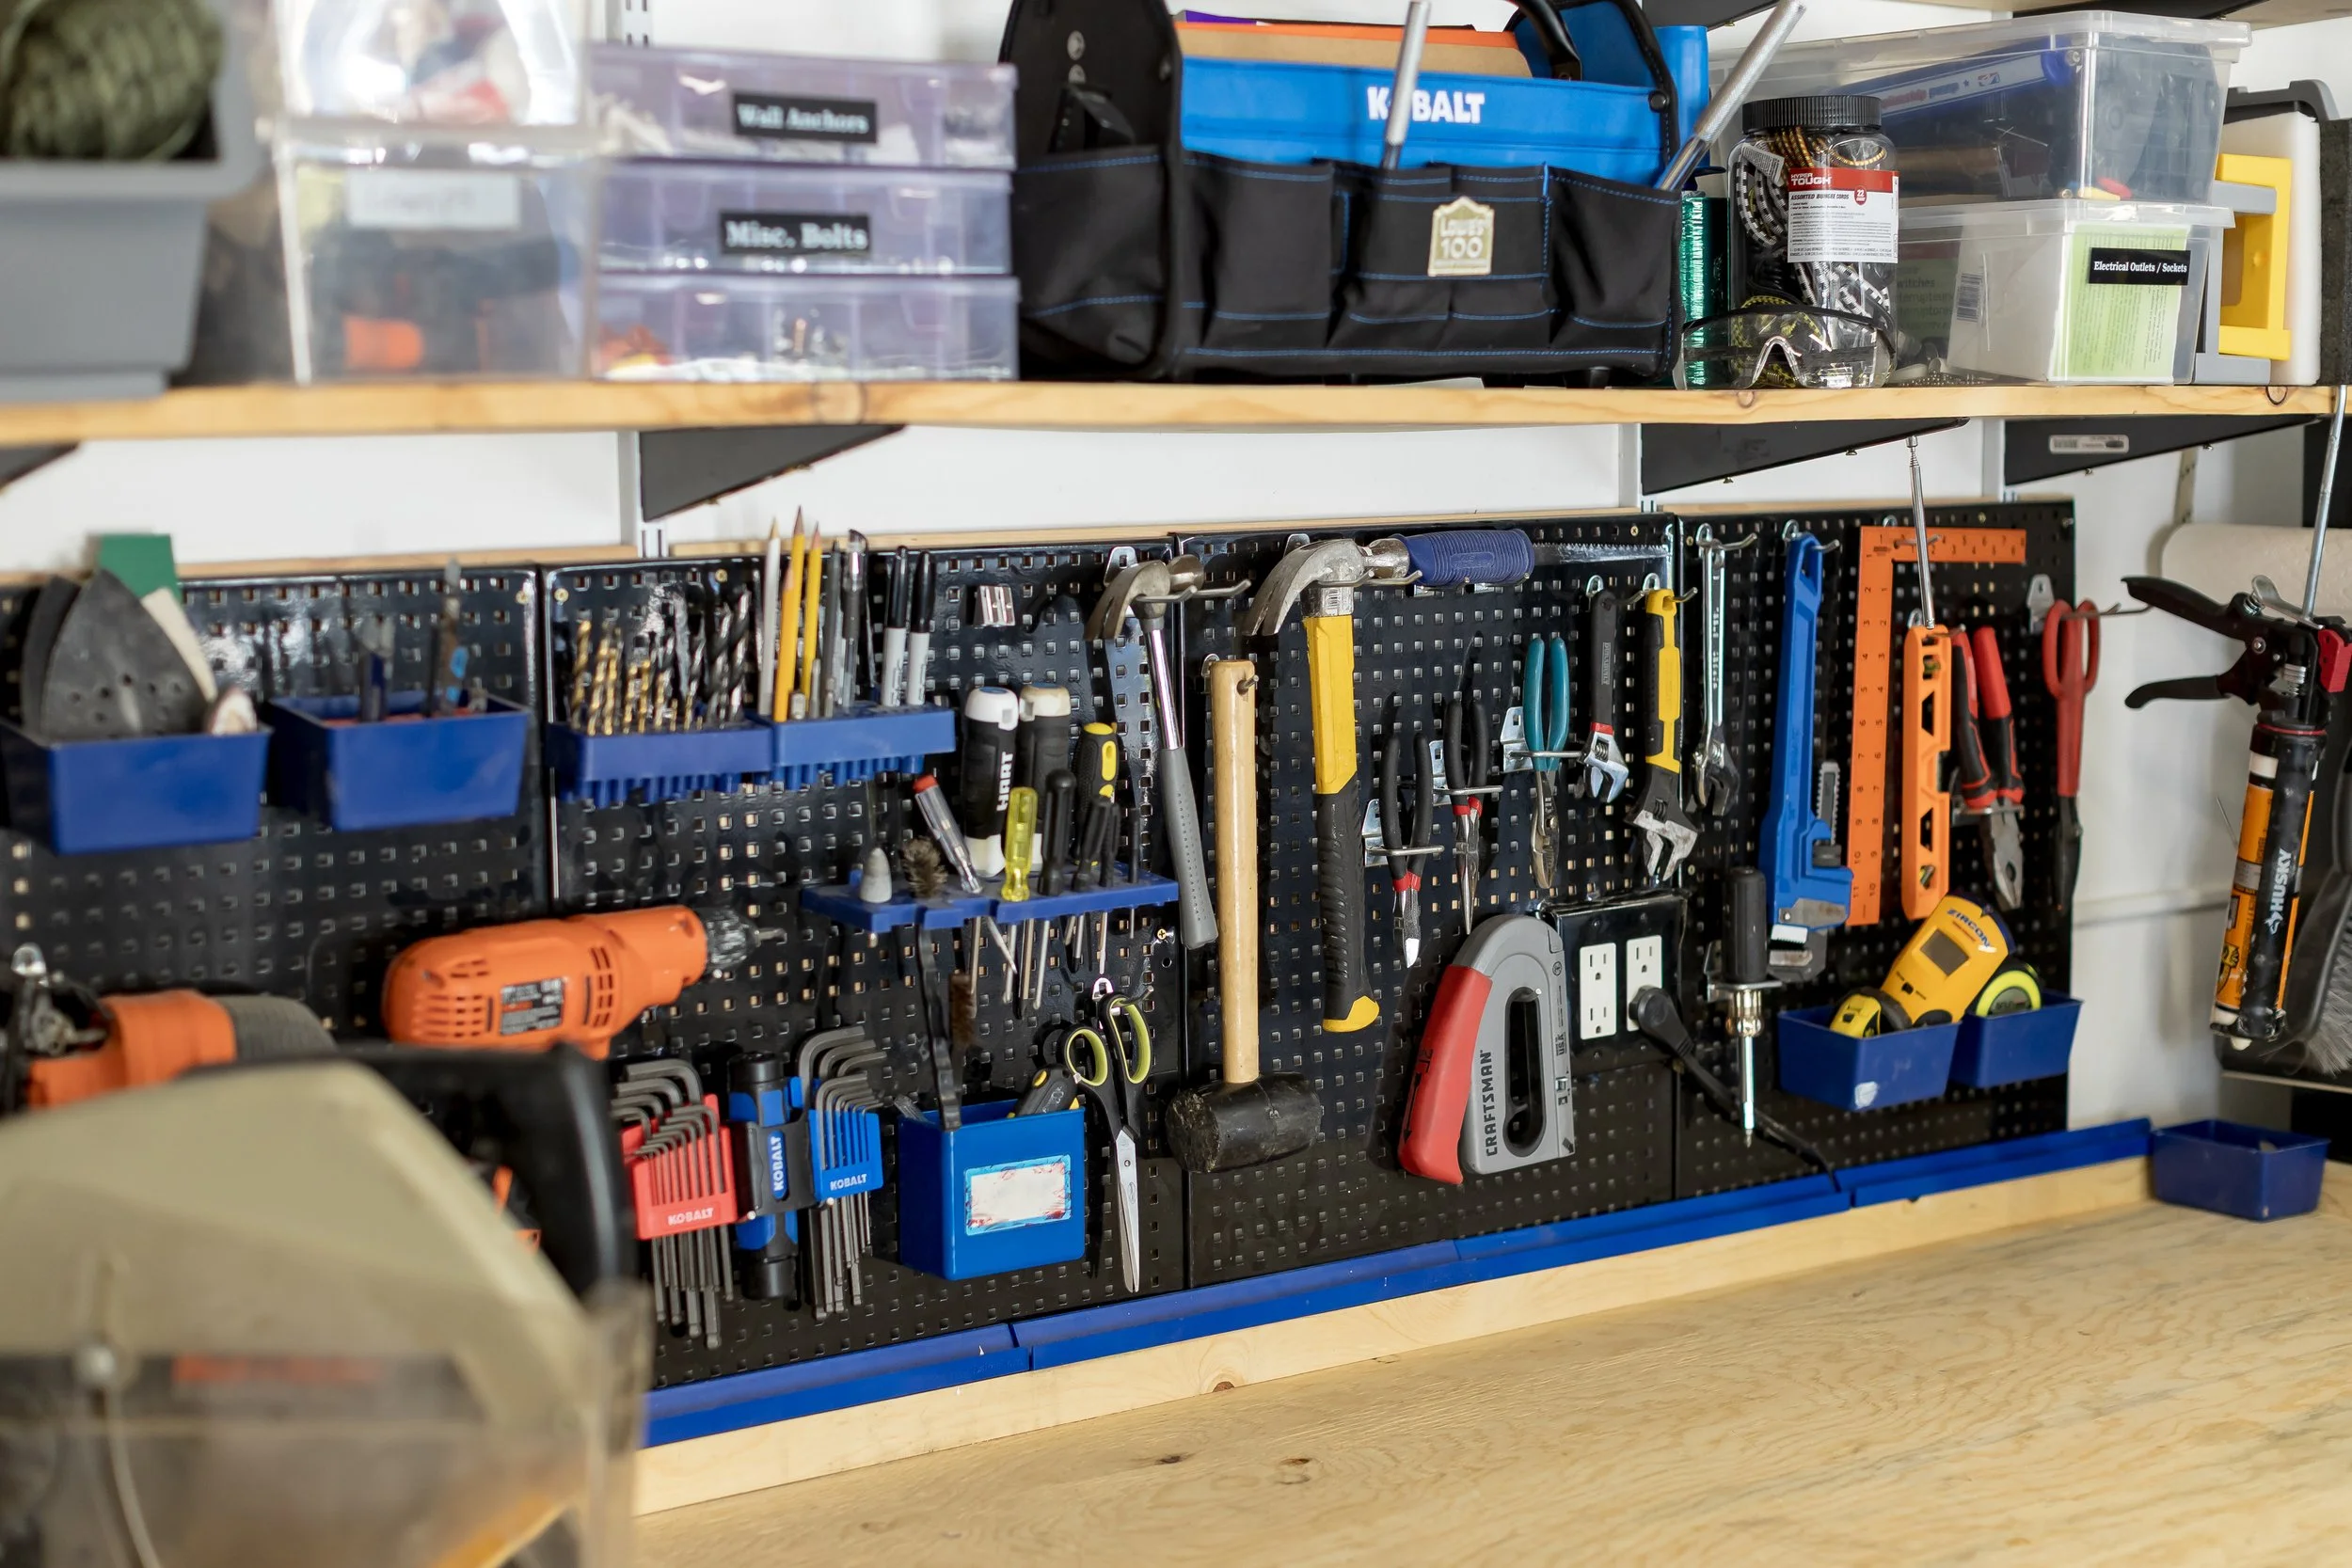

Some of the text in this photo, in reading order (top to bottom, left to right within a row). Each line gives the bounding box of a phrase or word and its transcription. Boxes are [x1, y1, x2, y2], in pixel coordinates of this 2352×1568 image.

[737, 103, 869, 134] Wall Anchors
[1367, 87, 1486, 123] KBALT
[1791, 177, 1832, 185] TOUGH
[725, 220, 868, 249] Misc. Bolts
[1441, 236, 1484, 259] 100
[2093, 261, 2187, 274] Electrical Outlets / Sockets
[996, 752, 1013, 811] HART
[2270, 847, 2292, 911] HUSKY
[1947, 908, 1991, 947] ZIRCON
[1480, 1051, 1498, 1157] CRAFTSMAN
[773, 1135, 784, 1192] KOBALT
[830, 1173, 867, 1192] KOBALT
[667, 1208, 715, 1227] KOBALT
